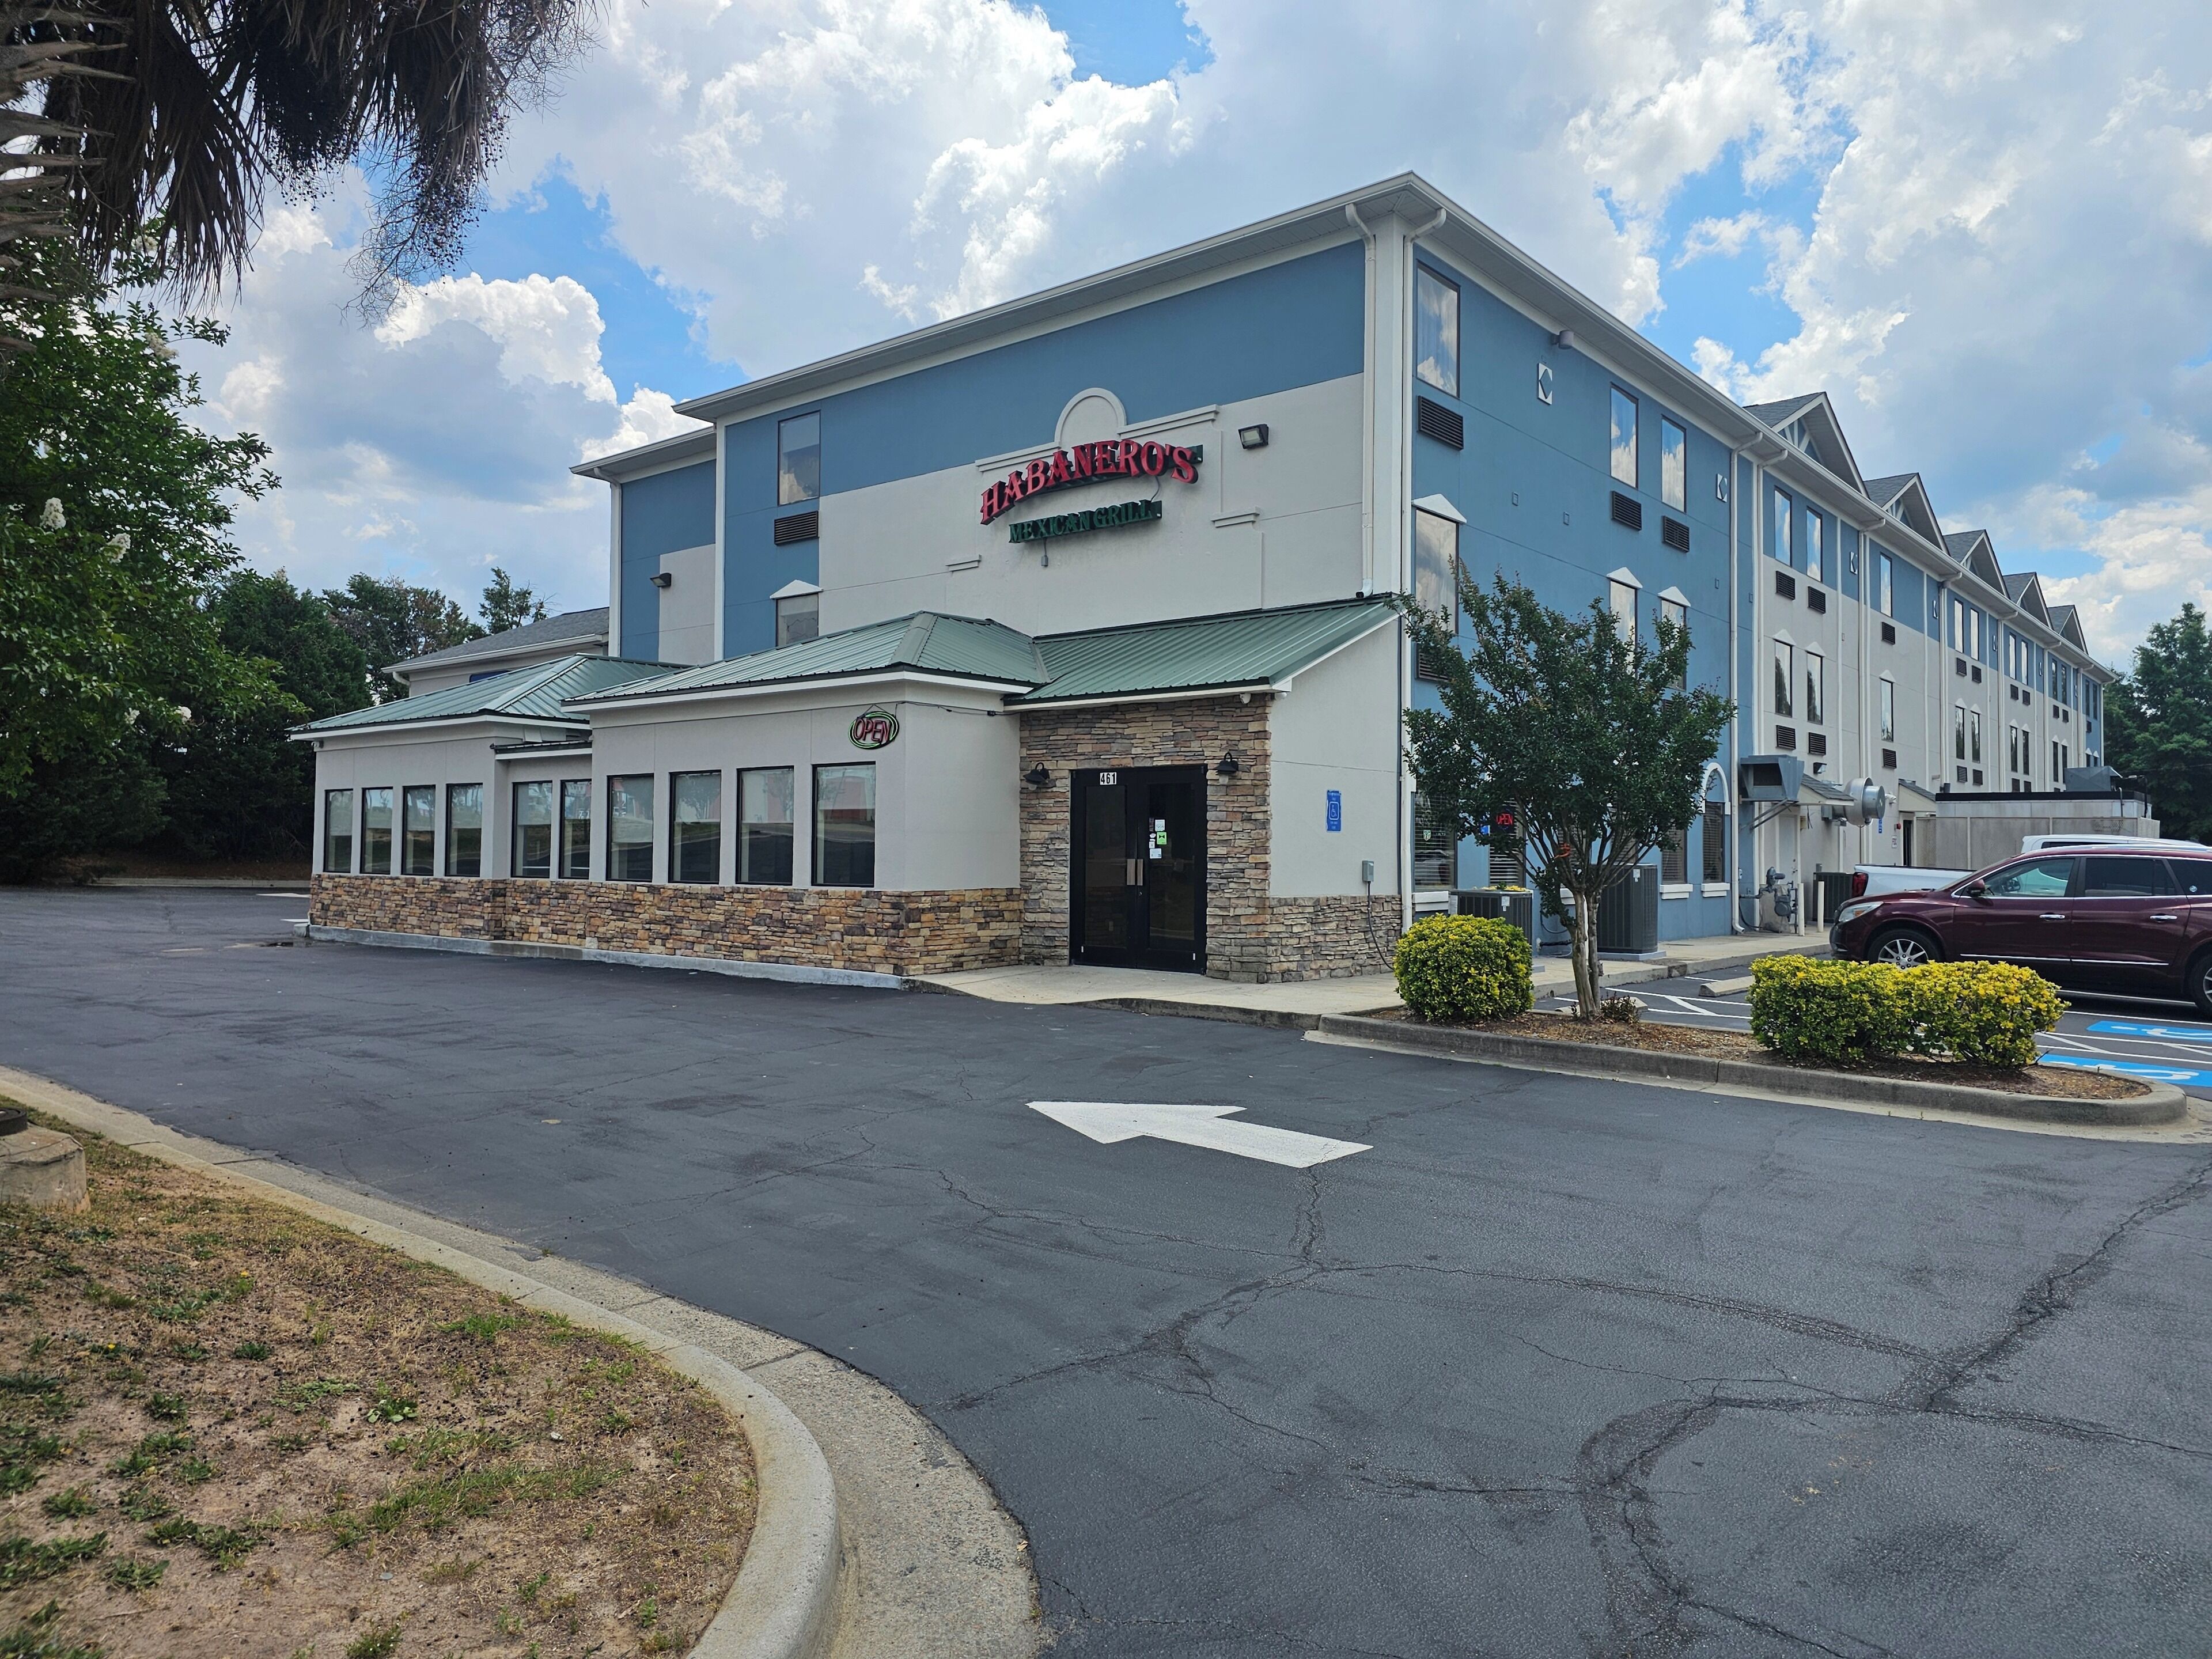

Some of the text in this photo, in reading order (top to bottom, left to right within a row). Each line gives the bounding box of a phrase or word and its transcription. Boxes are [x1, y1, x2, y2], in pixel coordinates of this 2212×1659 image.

[980, 440, 1198, 525] HABANERO'S
[1009, 500, 1153, 543] MEXICAN GRILL
[854, 718, 891, 744] OPEN
[1101, 772, 1115, 784] 461
